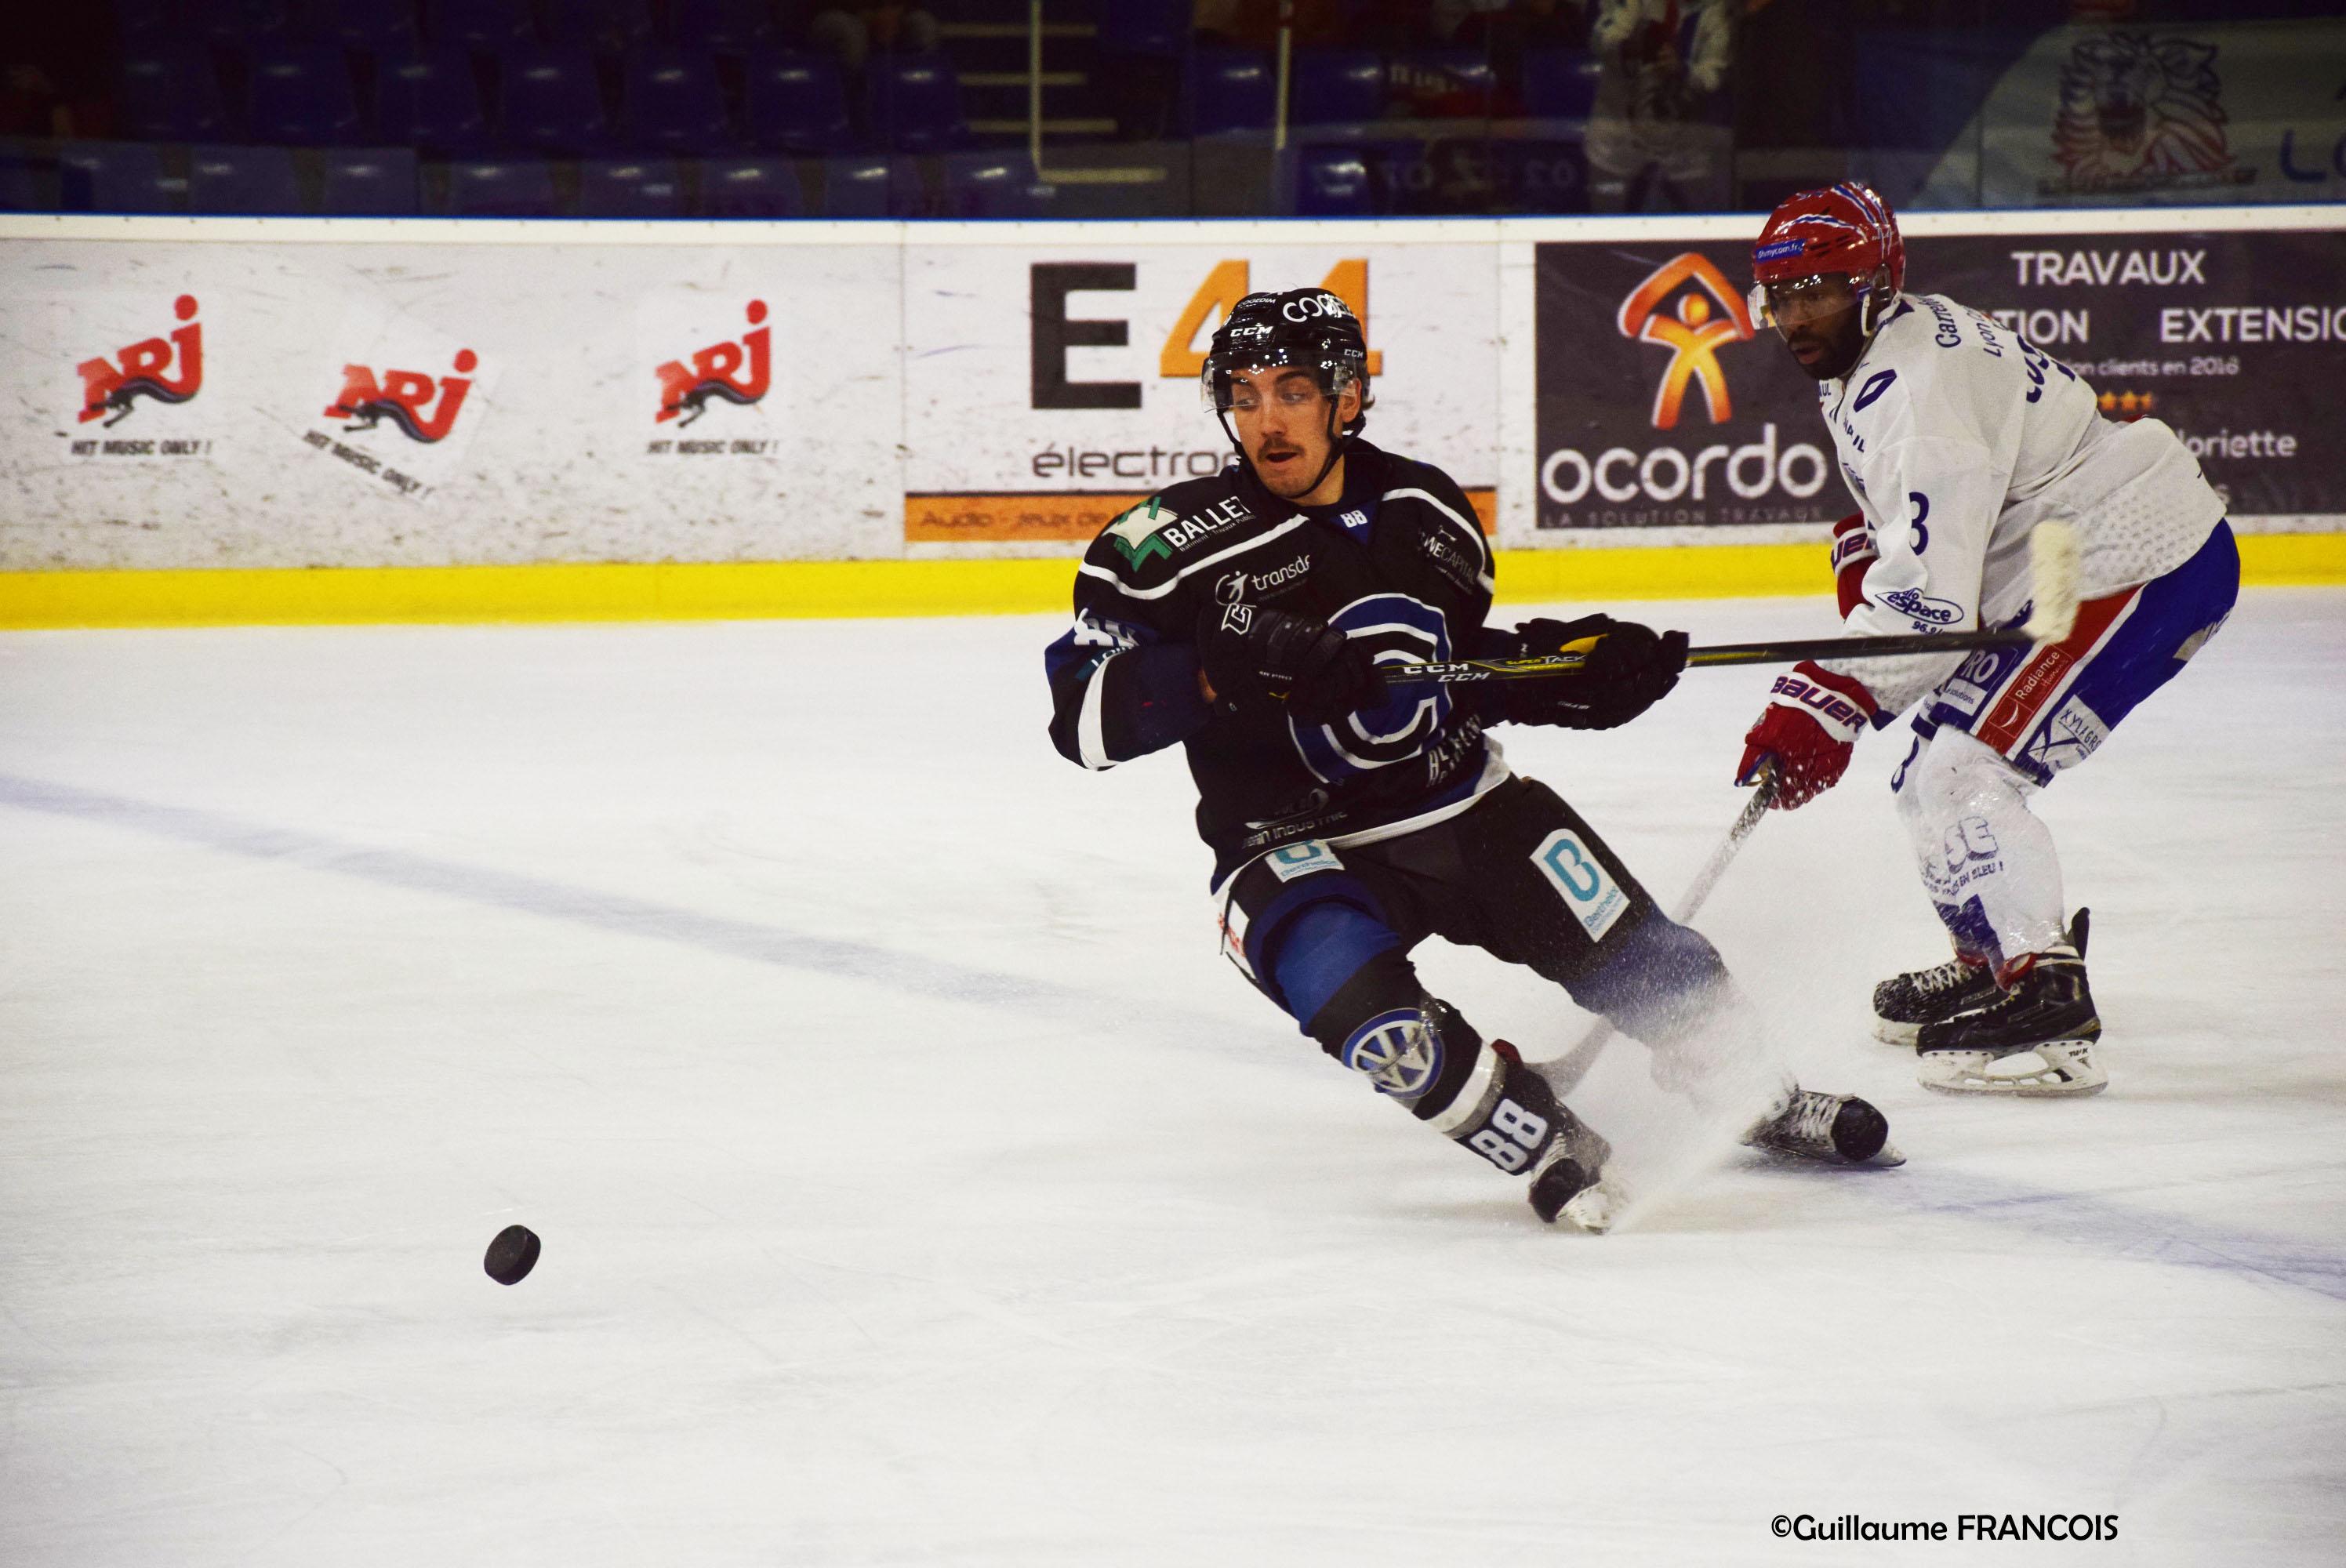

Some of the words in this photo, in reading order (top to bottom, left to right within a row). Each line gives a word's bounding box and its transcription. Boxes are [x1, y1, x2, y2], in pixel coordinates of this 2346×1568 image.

[2010, 250, 2206, 286] TRAVAUX
[1230, 325, 1274, 337] CCM
[1992, 309, 2089, 344] TION
[1344, 349, 1364, 358] CCM
[2162, 362, 2186, 376] en
[104, 440, 154, 456] MUSIC
[161, 440, 202, 456] ONLY
[2178, 428, 2298, 459] loriette
[1542, 423, 1828, 504] ocordo
[1340, 510, 1368, 528] 88
[1887, 593, 1951, 621] espace
[1404, 663, 1469, 674] CCM
[1438, 671, 1491, 683] CCM
[2015, 651, 2061, 699] Radiance
[1469, 1098, 1548, 1171] 88
